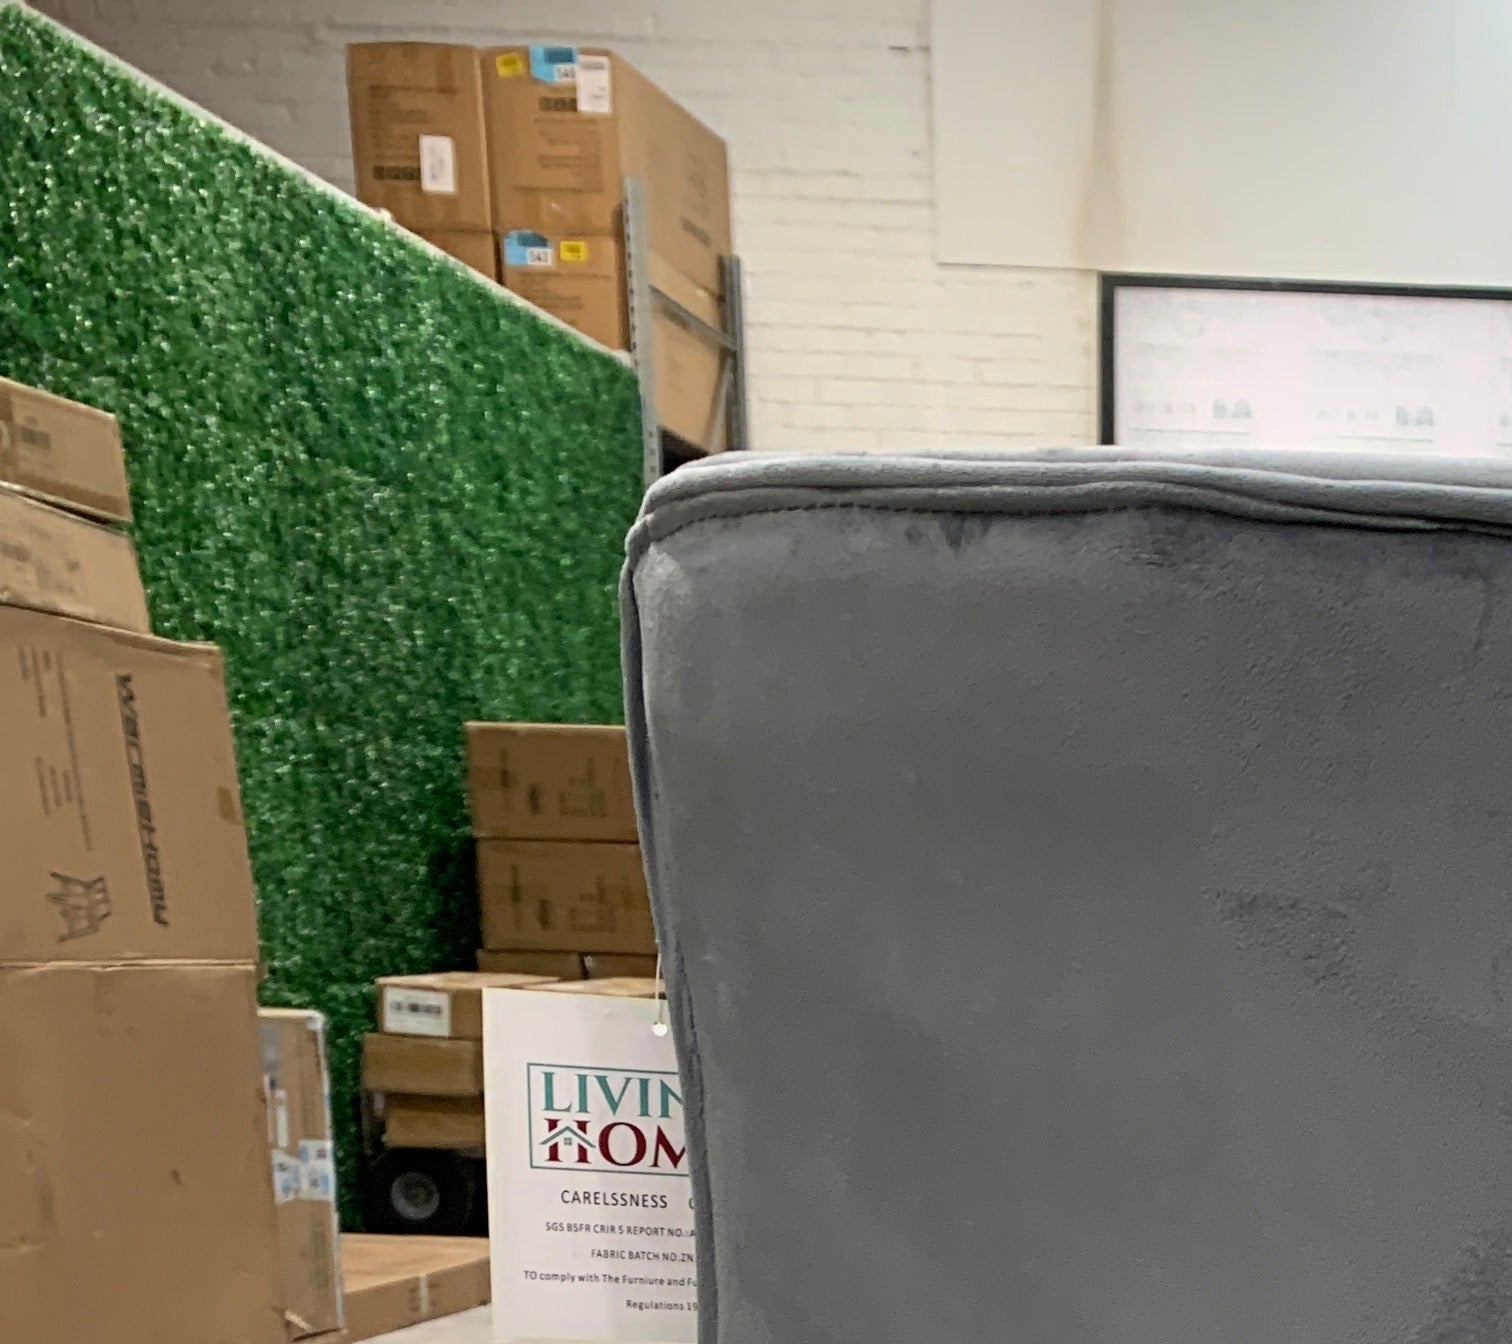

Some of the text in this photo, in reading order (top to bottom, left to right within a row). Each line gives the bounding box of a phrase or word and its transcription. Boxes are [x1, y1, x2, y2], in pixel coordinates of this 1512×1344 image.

[560, 1190, 668, 1209] CARELSSNESS
[546, 1221, 565, 1232] SGS
[566, 1222, 591, 1233] BSFR
[626, 1225, 664, 1237] REPORT
[591, 1248, 626, 1260] FABRIC
[628, 1250, 660, 1261] BATCH
[523, 1270, 538, 1280] TO
[539, 1272, 576, 1283] comply
[577, 1273, 601, 1283] with
[602, 1274, 620, 1284] The
[666, 1277, 685, 1287] and
[625, 1299, 684, 1312] Regulations
